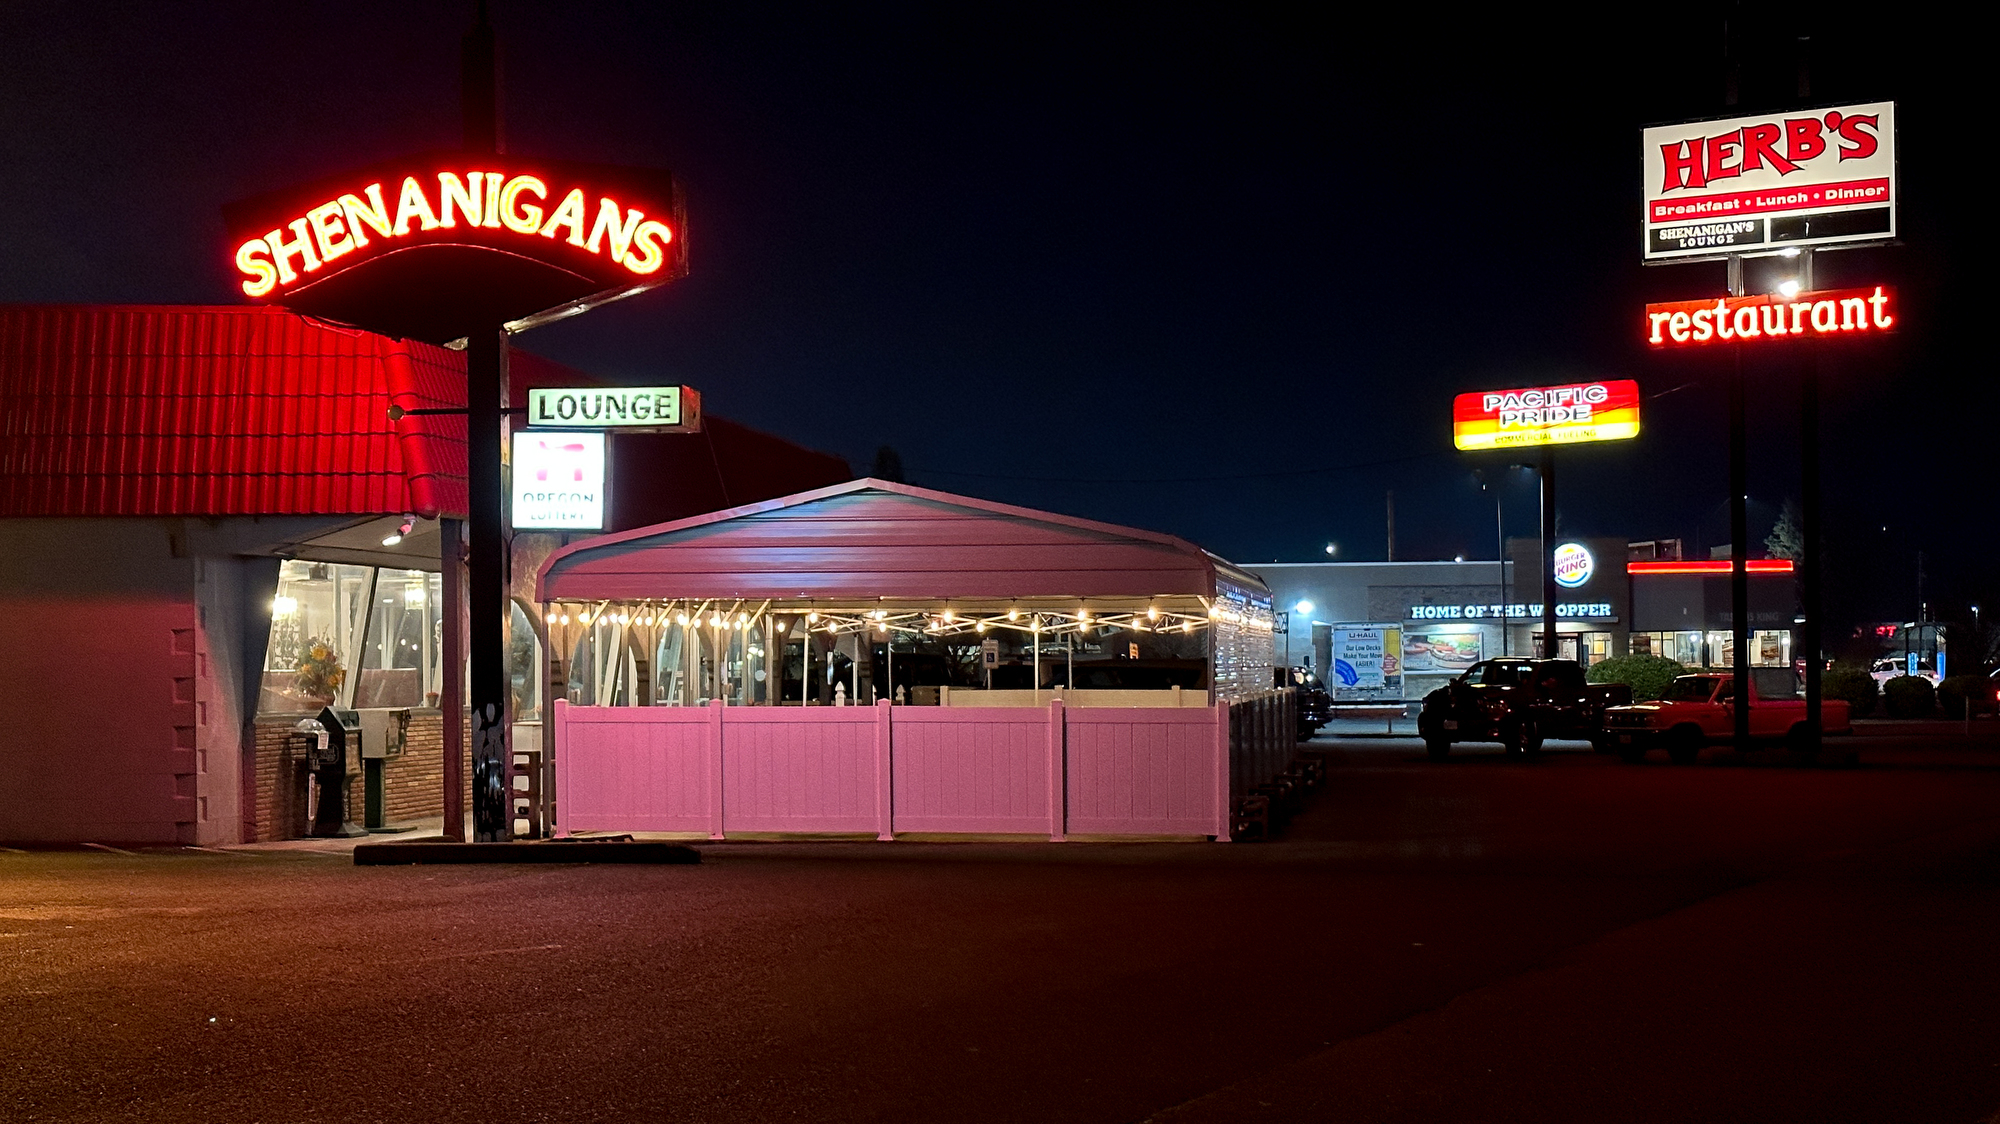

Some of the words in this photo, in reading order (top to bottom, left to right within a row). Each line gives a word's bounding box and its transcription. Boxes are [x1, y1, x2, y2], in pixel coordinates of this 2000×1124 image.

[1660, 110, 1880, 195] HERB'S
[1655, 198, 1740, 216] Breakfast
[1756, 192, 1808, 207] Lunch
[1825, 185, 1885, 200] Dinner
[235, 171, 672, 298] SHENANIGANS
[1659, 221, 1755, 240] SHENANIGAN'S
[1679, 234, 1735, 248] LOUNGE
[1649, 286, 1893, 344] restaurant
[538, 394, 672, 420] LOUNGE
[1483, 385, 1608, 412] PACIFIC
[1499, 405, 1593, 429] PRIDE
[1555, 552, 1585, 567] BURGER
[1557, 559, 1587, 577] KING
[1411, 605, 1461, 619] HOME
[1464, 605, 1488, 619] OF
[1490, 604, 1526, 618] THE
[1528, 603, 1612, 618] WOPPER
